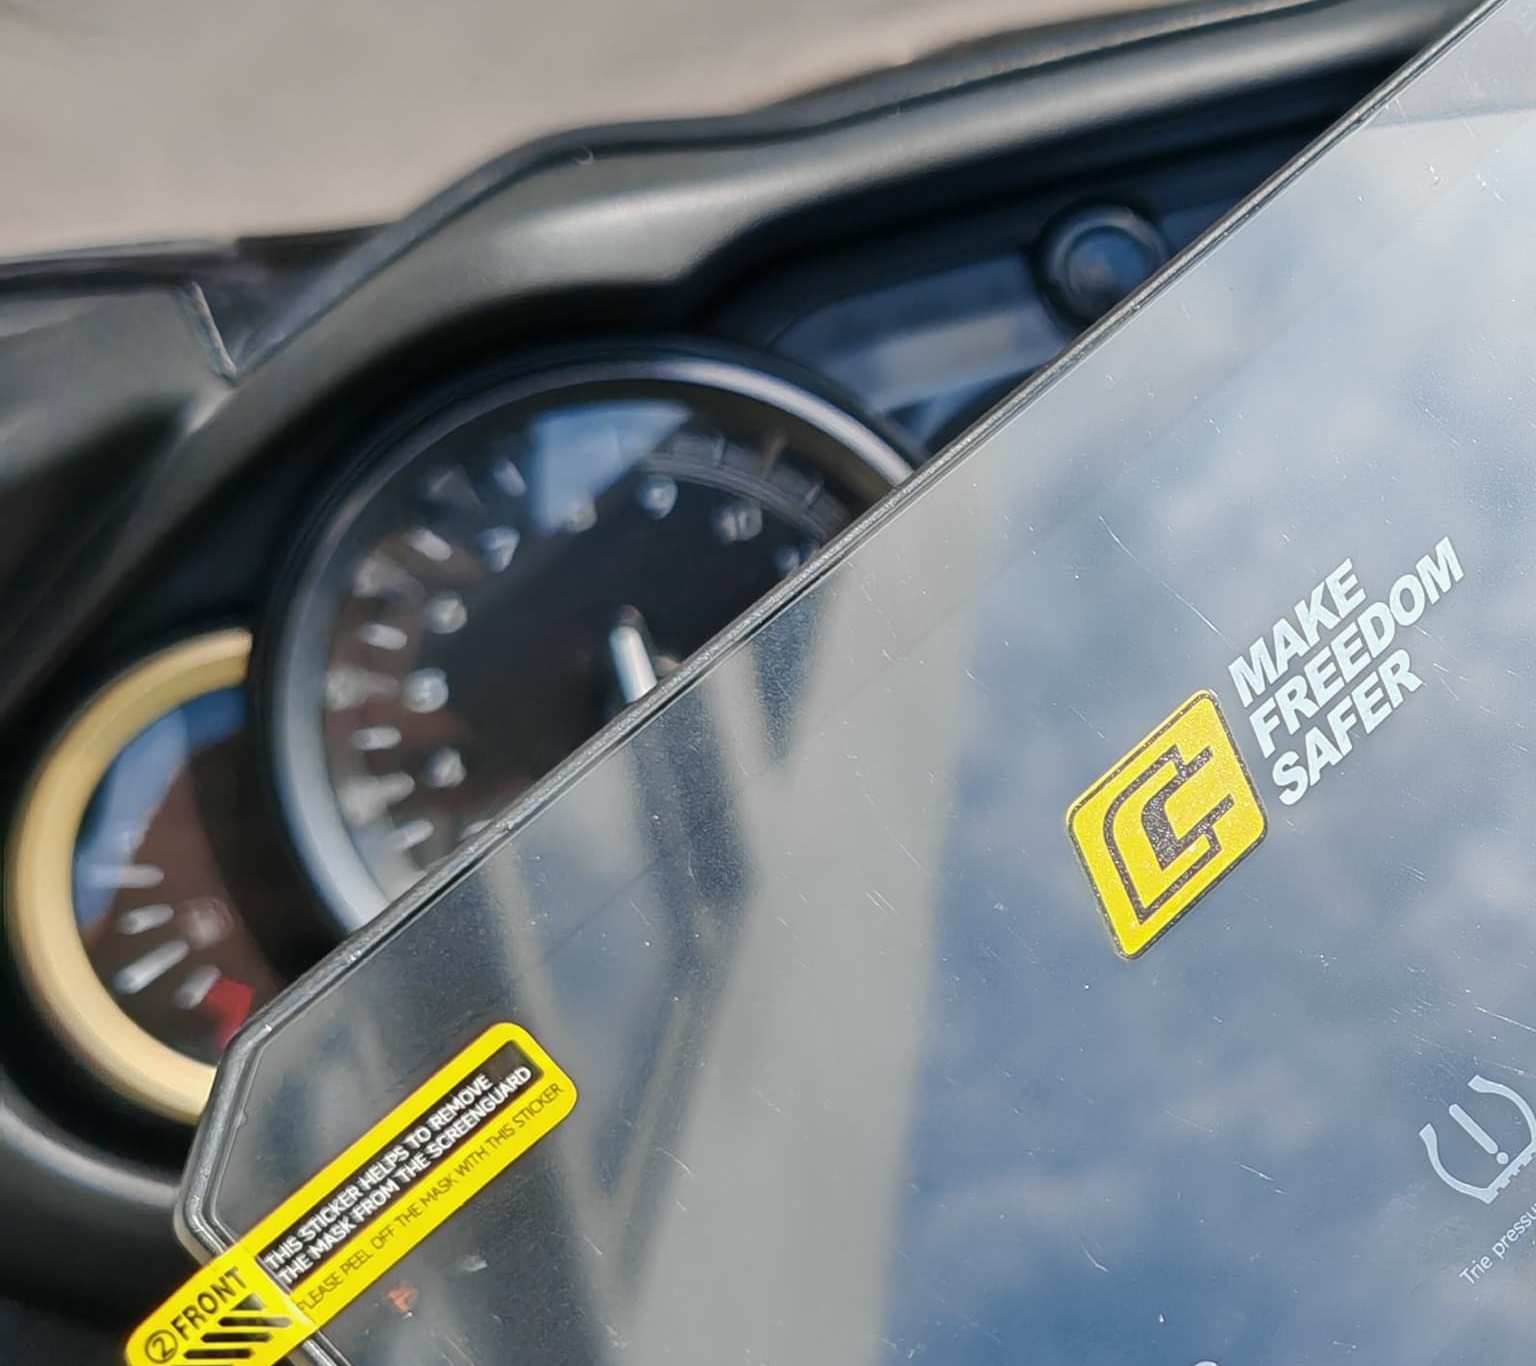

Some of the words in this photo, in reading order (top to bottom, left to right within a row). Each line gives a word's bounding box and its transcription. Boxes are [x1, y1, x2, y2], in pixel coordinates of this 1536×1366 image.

[1228, 558, 1366, 707] MAKE
[1249, 536, 1465, 758] FREEDOM
[1272, 649, 1424, 805] SAFER
[264, 1233, 302, 1271] THIS
[296, 1182, 363, 1244] STICKER
[355, 1143, 409, 1192] HELPS
[404, 1123, 432, 1152] TO
[427, 1072, 492, 1132] REMOVE
[277, 1251, 313, 1286] THE
[306, 1214, 356, 1261] MASK
[349, 1177, 400, 1224] FROM
[393, 1150, 430, 1187] THE
[424, 1064, 532, 1161] SCREENGUARD
[298, 1270, 344, 1313] PLEASE
[340, 1245, 372, 1276] PEEL
[370, 1224, 396, 1251] OFF
[395, 1202, 422, 1229] THE
[419, 1172, 456, 1207] MASK
[454, 1145, 488, 1178] WITH
[485, 1122, 516, 1150] THIS
[513, 1081, 563, 1127] STICKER
[172, 1268, 247, 1339] FRONT
[1459, 1255, 1493, 1285] Trie
